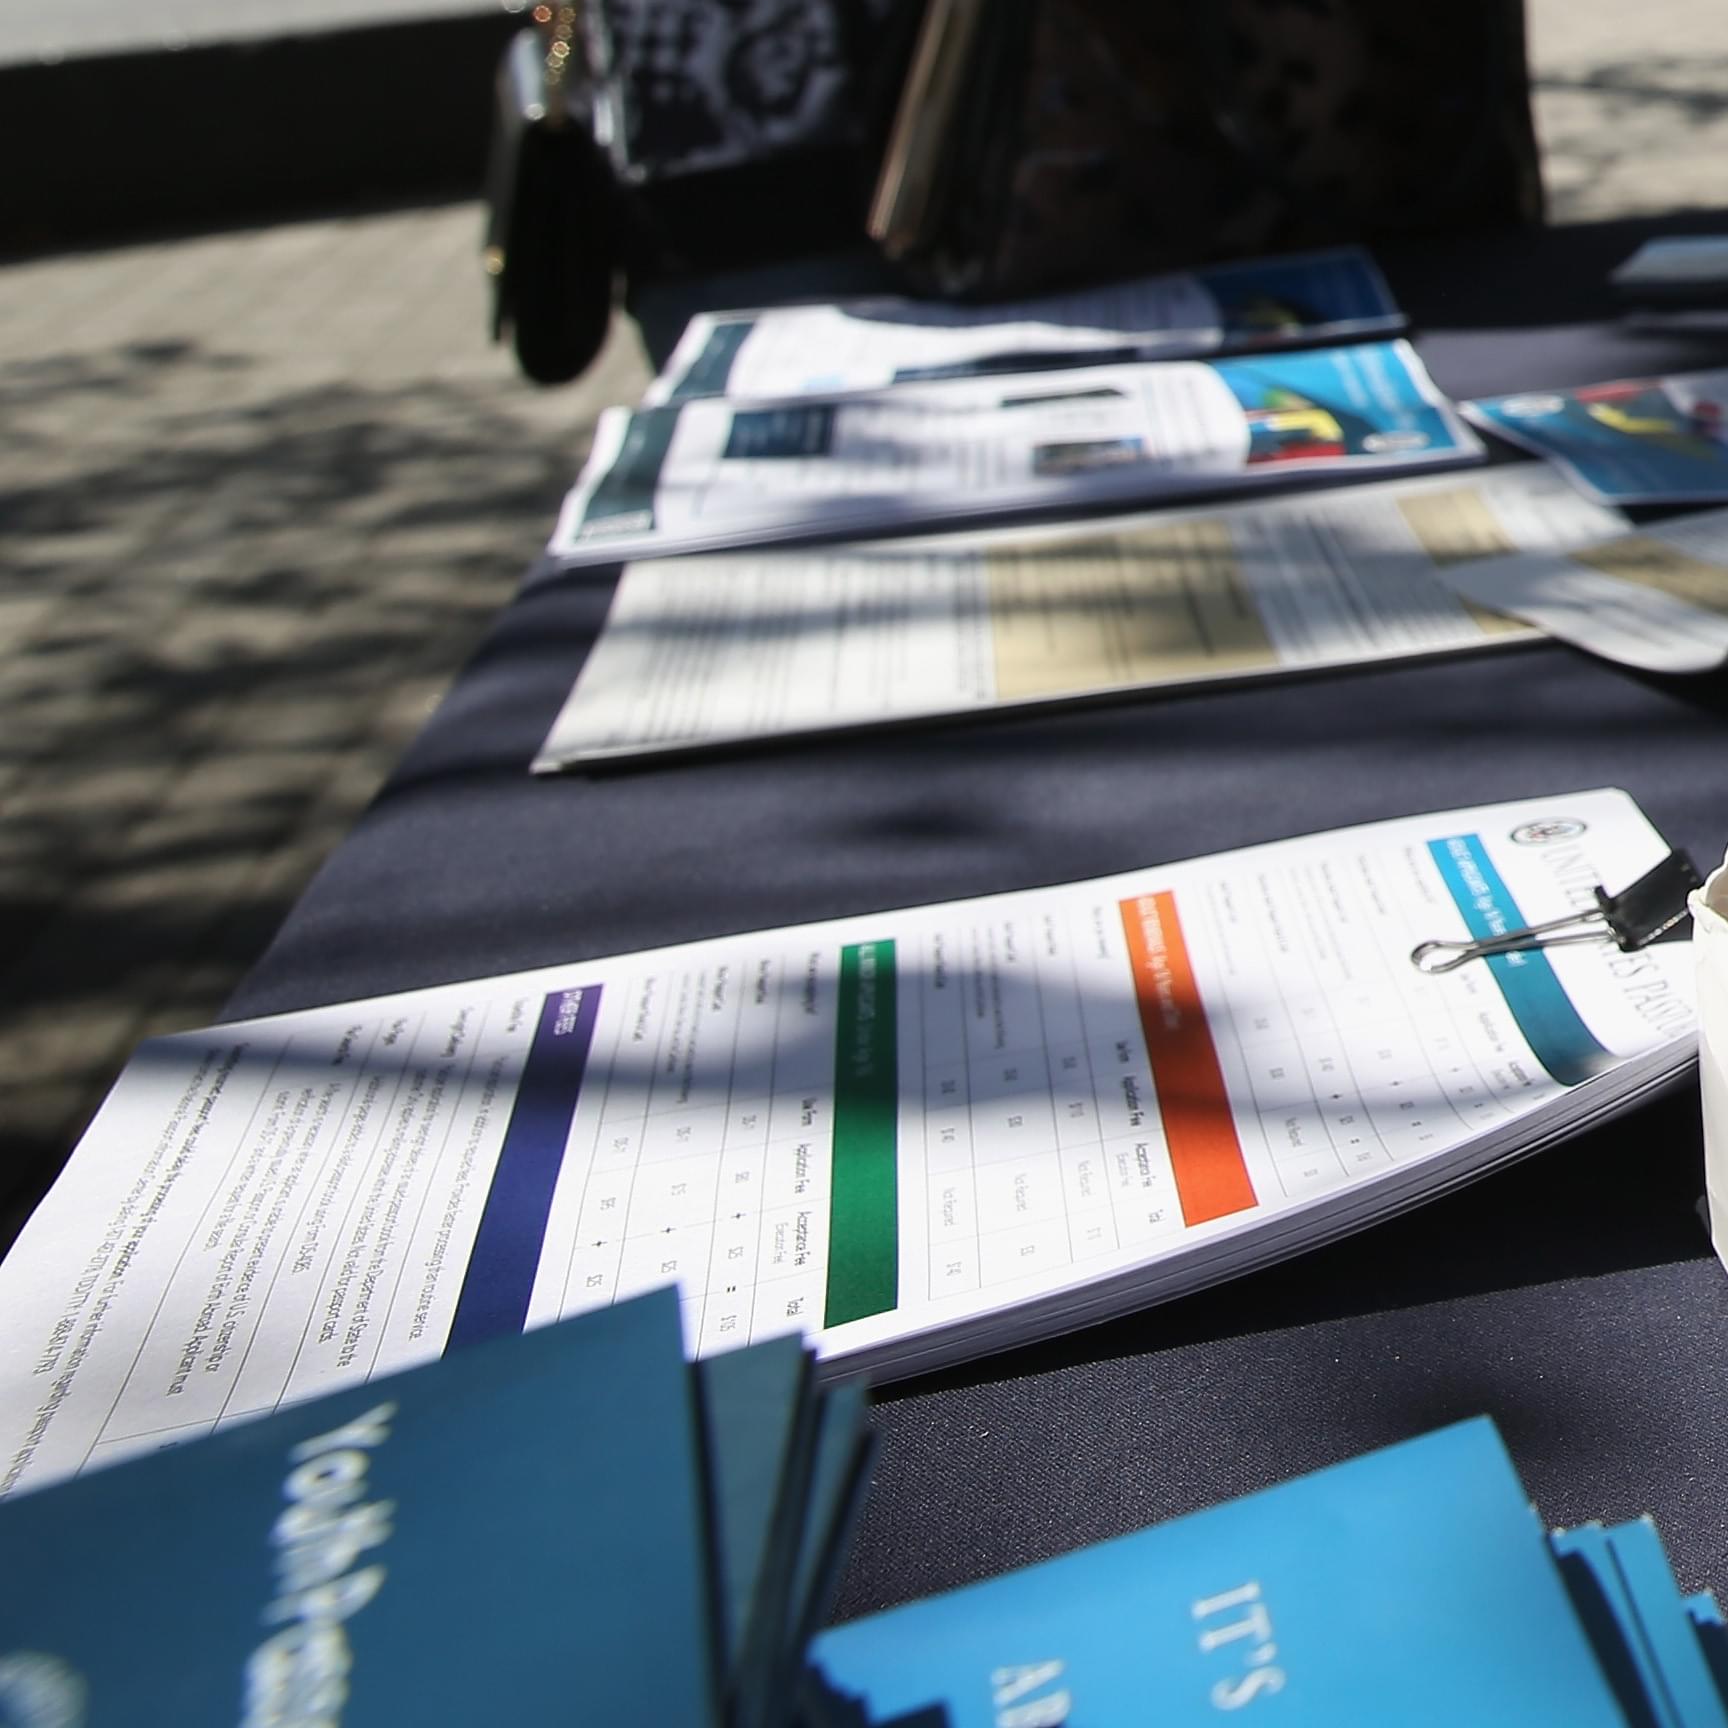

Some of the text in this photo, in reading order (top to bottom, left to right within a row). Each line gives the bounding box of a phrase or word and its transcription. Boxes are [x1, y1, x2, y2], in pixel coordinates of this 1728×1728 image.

[345, 1244, 366, 1260] Not
[424, 1228, 451, 1266] processing
[234, 1260, 260, 1293] evidence
[353, 1268, 384, 1314] Department
[324, 1286, 348, 1320] passport
[416, 1283, 436, 1311] routine
[192, 1302, 221, 1334] Abroad.
[317, 1320, 338, 1344] cards.
[344, 1322, 368, 1344] State
[408, 1310, 428, 1340] service.
[65, 1322, 102, 1370] information
[175, 1334, 207, 1374] Applicant
[207, 1319, 237, 1362] citizenship
[166, 1374, 188, 1396] must
[1191, 1579, 1288, 1711] IT'S
